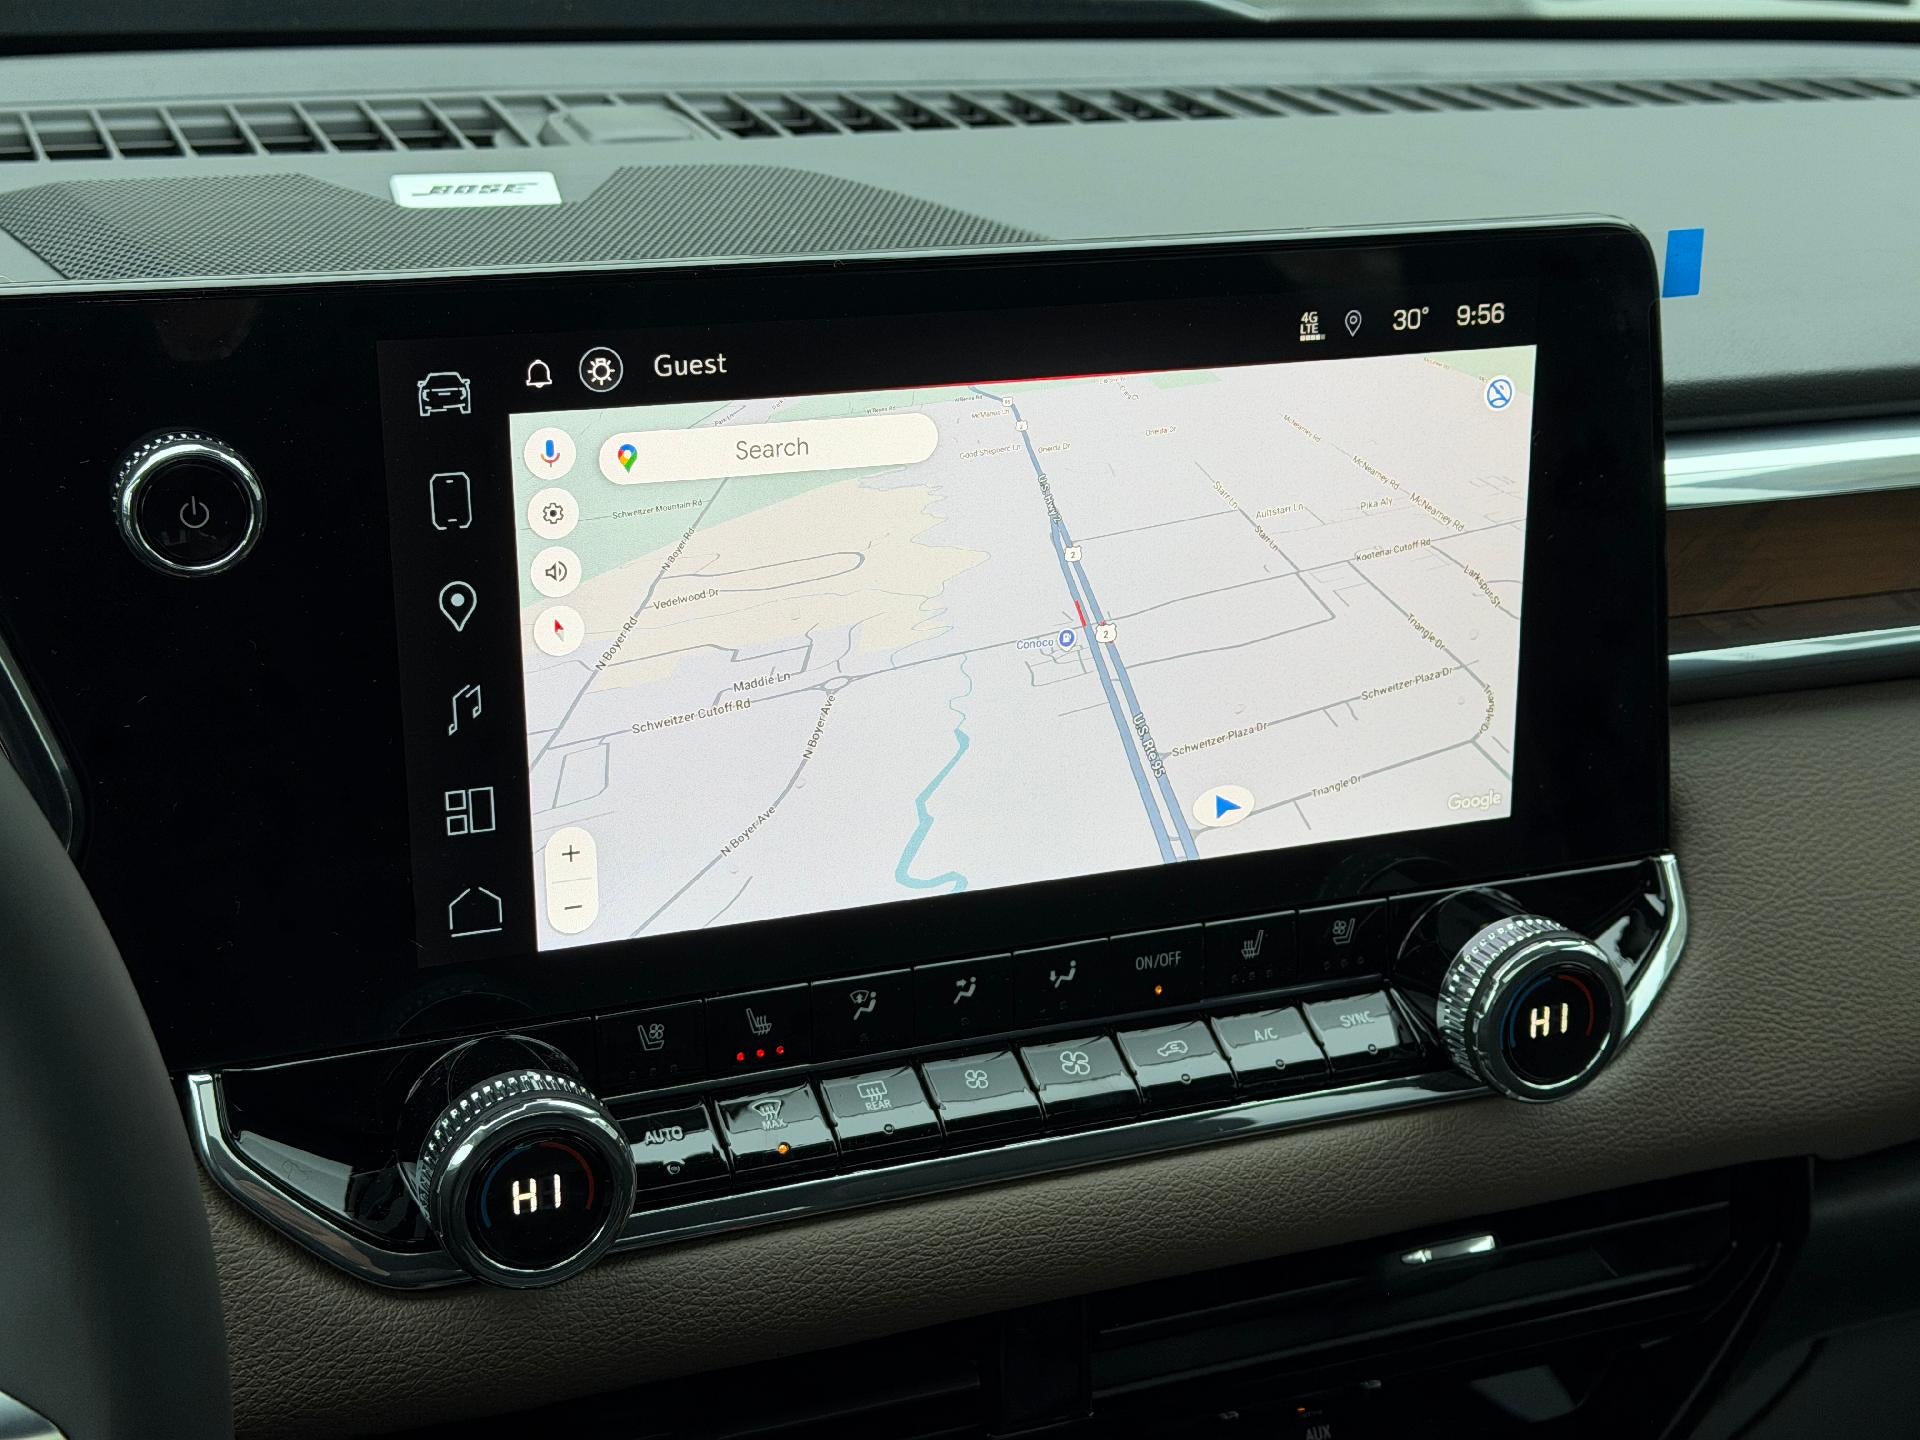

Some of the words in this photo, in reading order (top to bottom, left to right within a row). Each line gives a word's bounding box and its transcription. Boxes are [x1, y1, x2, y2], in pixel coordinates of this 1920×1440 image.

[412, 182, 539, 197] BOSE
[1301, 312, 1319, 323] 4G
[1393, 306, 1430, 331] 30°
[1456, 302, 1505, 326] 9:56
[1300, 323, 1320, 334] LTE
[654, 353, 728, 377] Guest
[736, 437, 809, 461] Search
[1352, 456, 1389, 485] McNearney
[1389, 479, 1400, 491] Rd
[1214, 481, 1230, 500] Starr
[612, 505, 654, 520] Schweitzer
[656, 501, 691, 514] Mountain
[692, 499, 703, 508] Rd
[1360, 501, 1378, 511] Pika
[1410, 492, 1452, 526] McNearney
[1453, 519, 1465, 532] Rd
[668, 538, 687, 563] Boyer
[683, 527, 695, 540] Rd
[1255, 525, 1271, 545] Starr
[1356, 548, 1393, 562] Kootenai
[1394, 540, 1419, 553] Cutoff
[1420, 538, 1431, 547] Rd
[708, 588, 719, 598] Dr
[1464, 565, 1494, 599] Larkspur
[1407, 613, 1436, 642] Triangle
[595, 659, 606, 671] N
[602, 630, 627, 661] Boyer
[624, 616, 638, 633] Rd
[1016, 638, 1054, 650] Conoco
[733, 675, 775, 693] Maddie
[777, 672, 791, 682] Ln
[1361, 681, 1414, 701] Schweitzer
[1415, 670, 1440, 684] Plaza
[1442, 667, 1454, 676] Dr
[823, 694, 836, 716] Ave
[1483, 684, 1495, 723] Triangle
[631, 711, 695, 735] Schweitzer
[698, 701, 733, 720] Cutoff
[736, 698, 751, 711] Rd
[807, 714, 826, 749] Boyer
[1172, 735, 1226, 757] Schweitzer
[1227, 727, 1255, 741] Plaza
[1256, 722, 1268, 731] Dr
[803, 748, 813, 760] N
[1133, 712, 1149, 739] U.S.
[1142, 737, 1160, 762] Rte
[1151, 759, 1166, 778] 95
[1312, 779, 1349, 798] Triangle
[1350, 775, 1361, 784] Dr
[1447, 789, 1502, 810] Google
[720, 845, 732, 857] N
[729, 820, 759, 850] Boyer
[756, 805, 777, 827] Ave
[1135, 951, 1182, 971] ON/OFF
[1339, 1011, 1375, 1028] SYNC
[1529, 1002, 1569, 1040] HI
[1254, 1026, 1279, 1042] A/C
[865, 1099, 892, 1112] REAR
[644, 1125, 684, 1145] AUTO
[761, 1118, 786, 1131] MAX
[511, 1173, 562, 1216] HI
[1306, 1424, 1332, 1440] AUX
